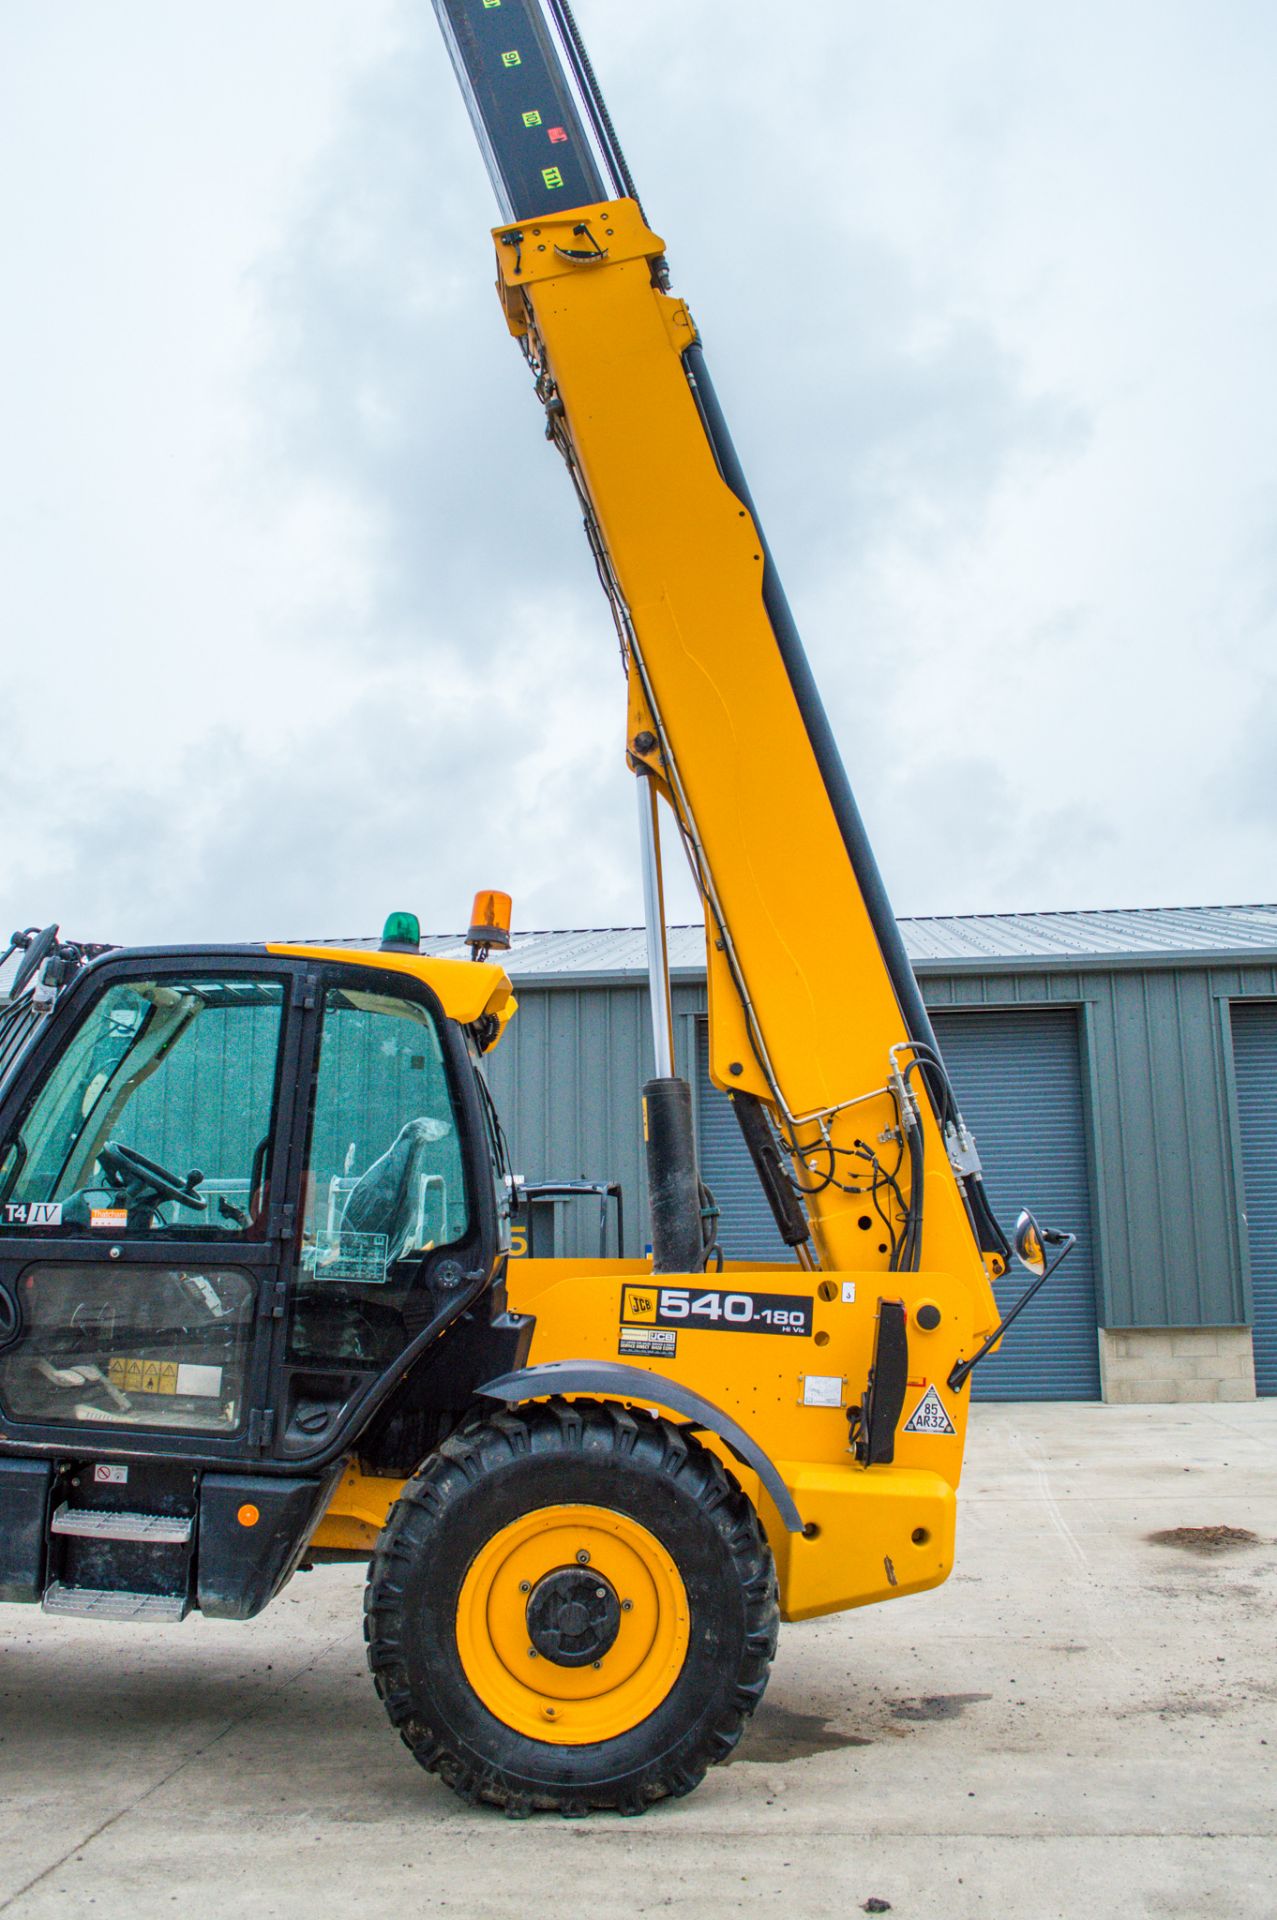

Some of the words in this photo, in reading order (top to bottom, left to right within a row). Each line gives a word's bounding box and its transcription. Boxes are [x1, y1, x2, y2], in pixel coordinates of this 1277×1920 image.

[525, 111, 539, 123] 10
[544, 168, 560, 181] 11
[5, 1204, 27, 1222] T4
[32, 1205, 58, 1222] IV
[93, 1210, 127, 1219] Thatcham
[631, 1296, 651, 1312] JCB
[782, 1325, 791, 1333] Hi
[649, 1332, 675, 1342] JCB
[924, 1402, 938, 1416] 85
[916, 1414, 945, 1429] AR3Z
